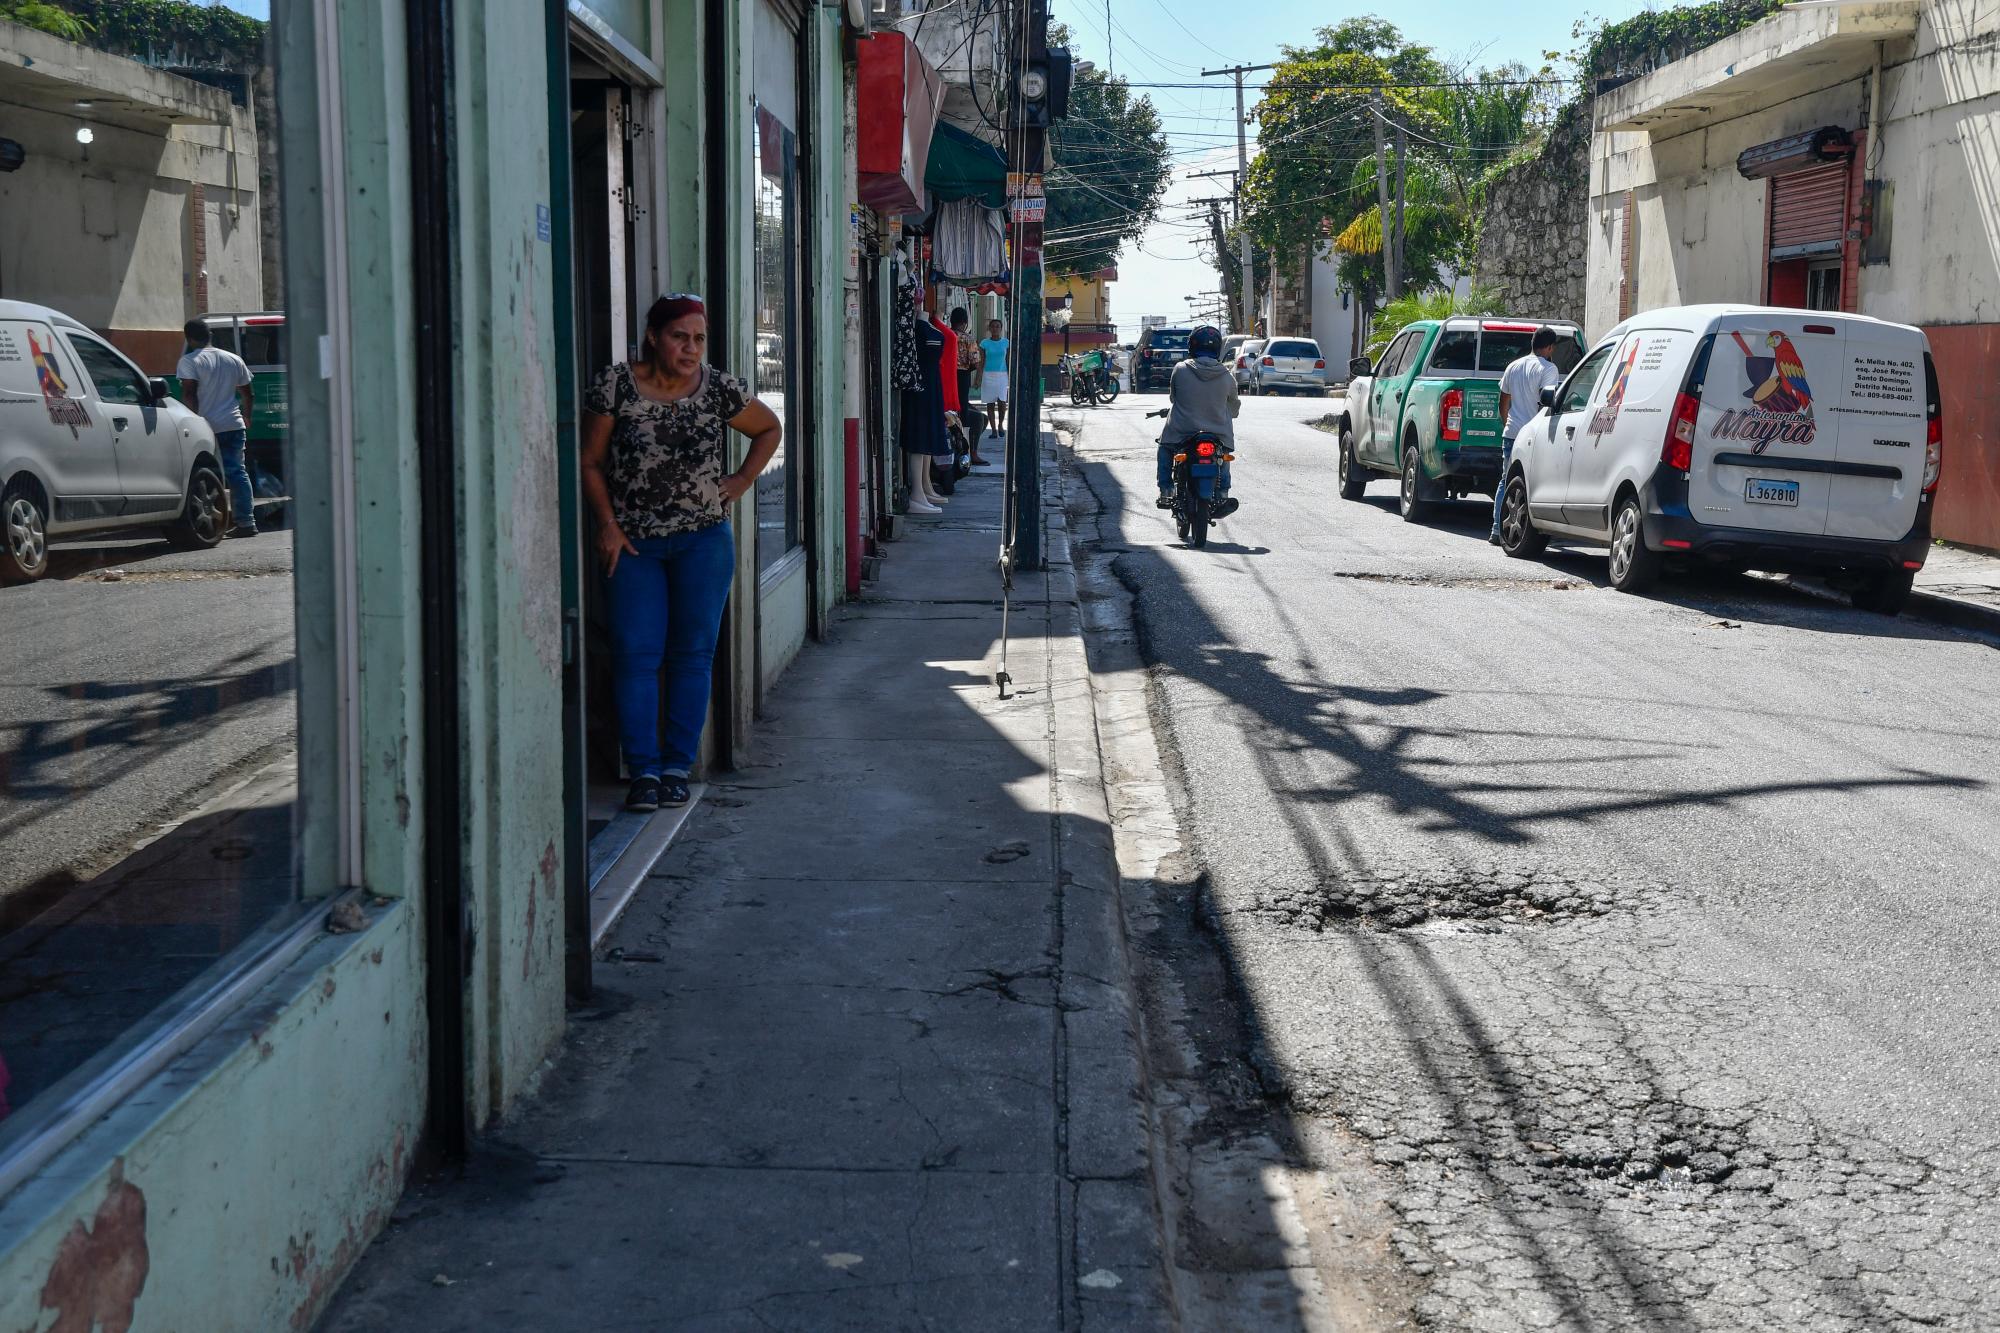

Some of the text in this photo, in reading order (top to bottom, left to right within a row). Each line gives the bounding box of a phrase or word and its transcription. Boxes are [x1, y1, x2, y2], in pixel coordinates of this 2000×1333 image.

[1866, 358, 1886, 366] Mella
[1857, 374, 1911, 386] Santo Domingo,
[1854, 382, 1912, 393] Distrito Nacional
[1473, 409, 1494, 418] F-89
[1711, 408, 1814, 455] Mayra
[1873, 439, 1911, 448] DOKKER
